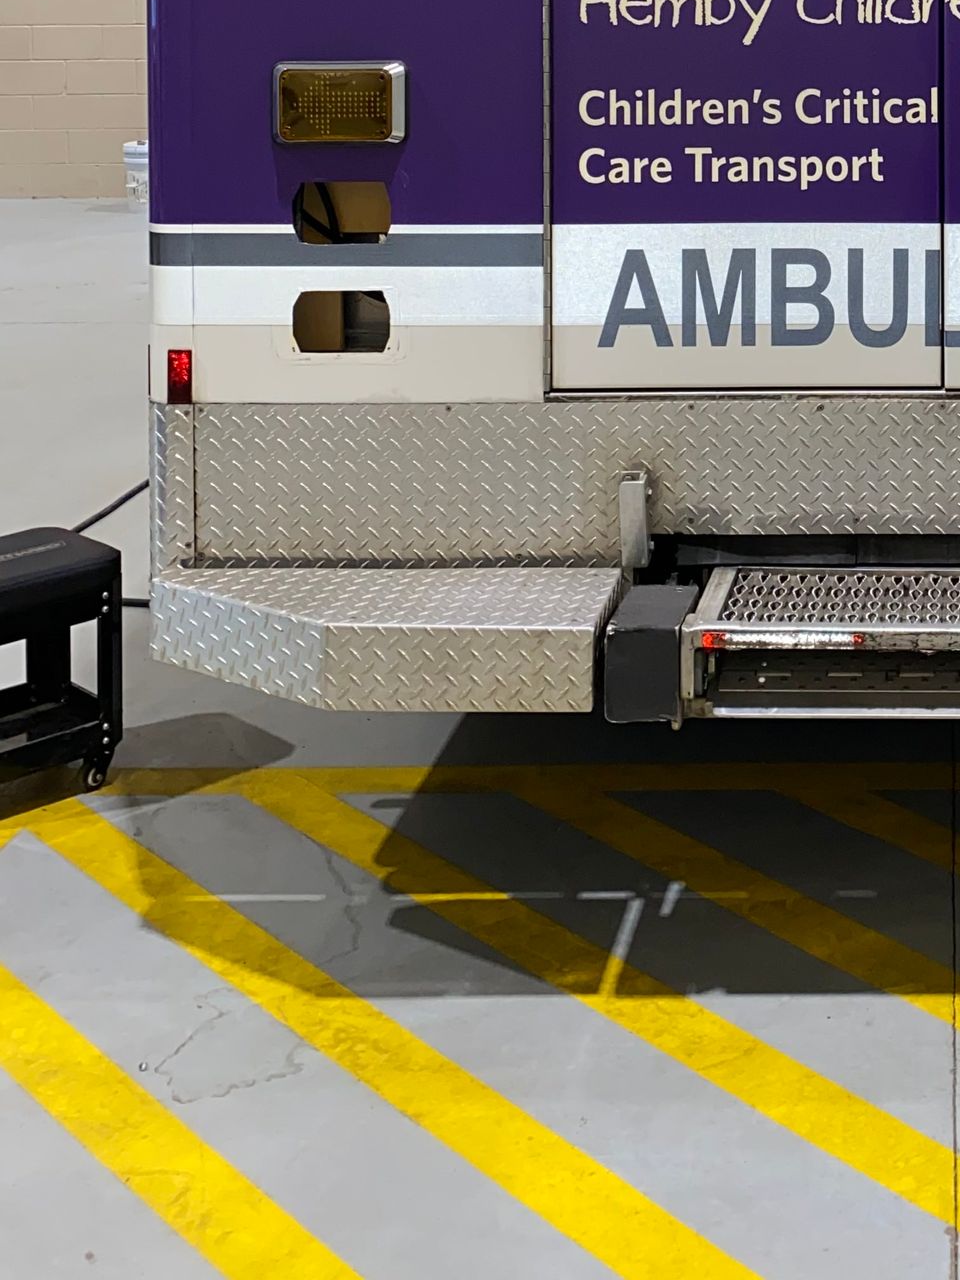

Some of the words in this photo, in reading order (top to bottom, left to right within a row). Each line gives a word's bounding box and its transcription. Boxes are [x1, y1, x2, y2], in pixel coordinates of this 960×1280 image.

[578, 88, 783, 126] Children's
[795, 87, 939, 124] Critical
[578, 147, 673, 184] Care
[684, 147, 885, 191] Transport
